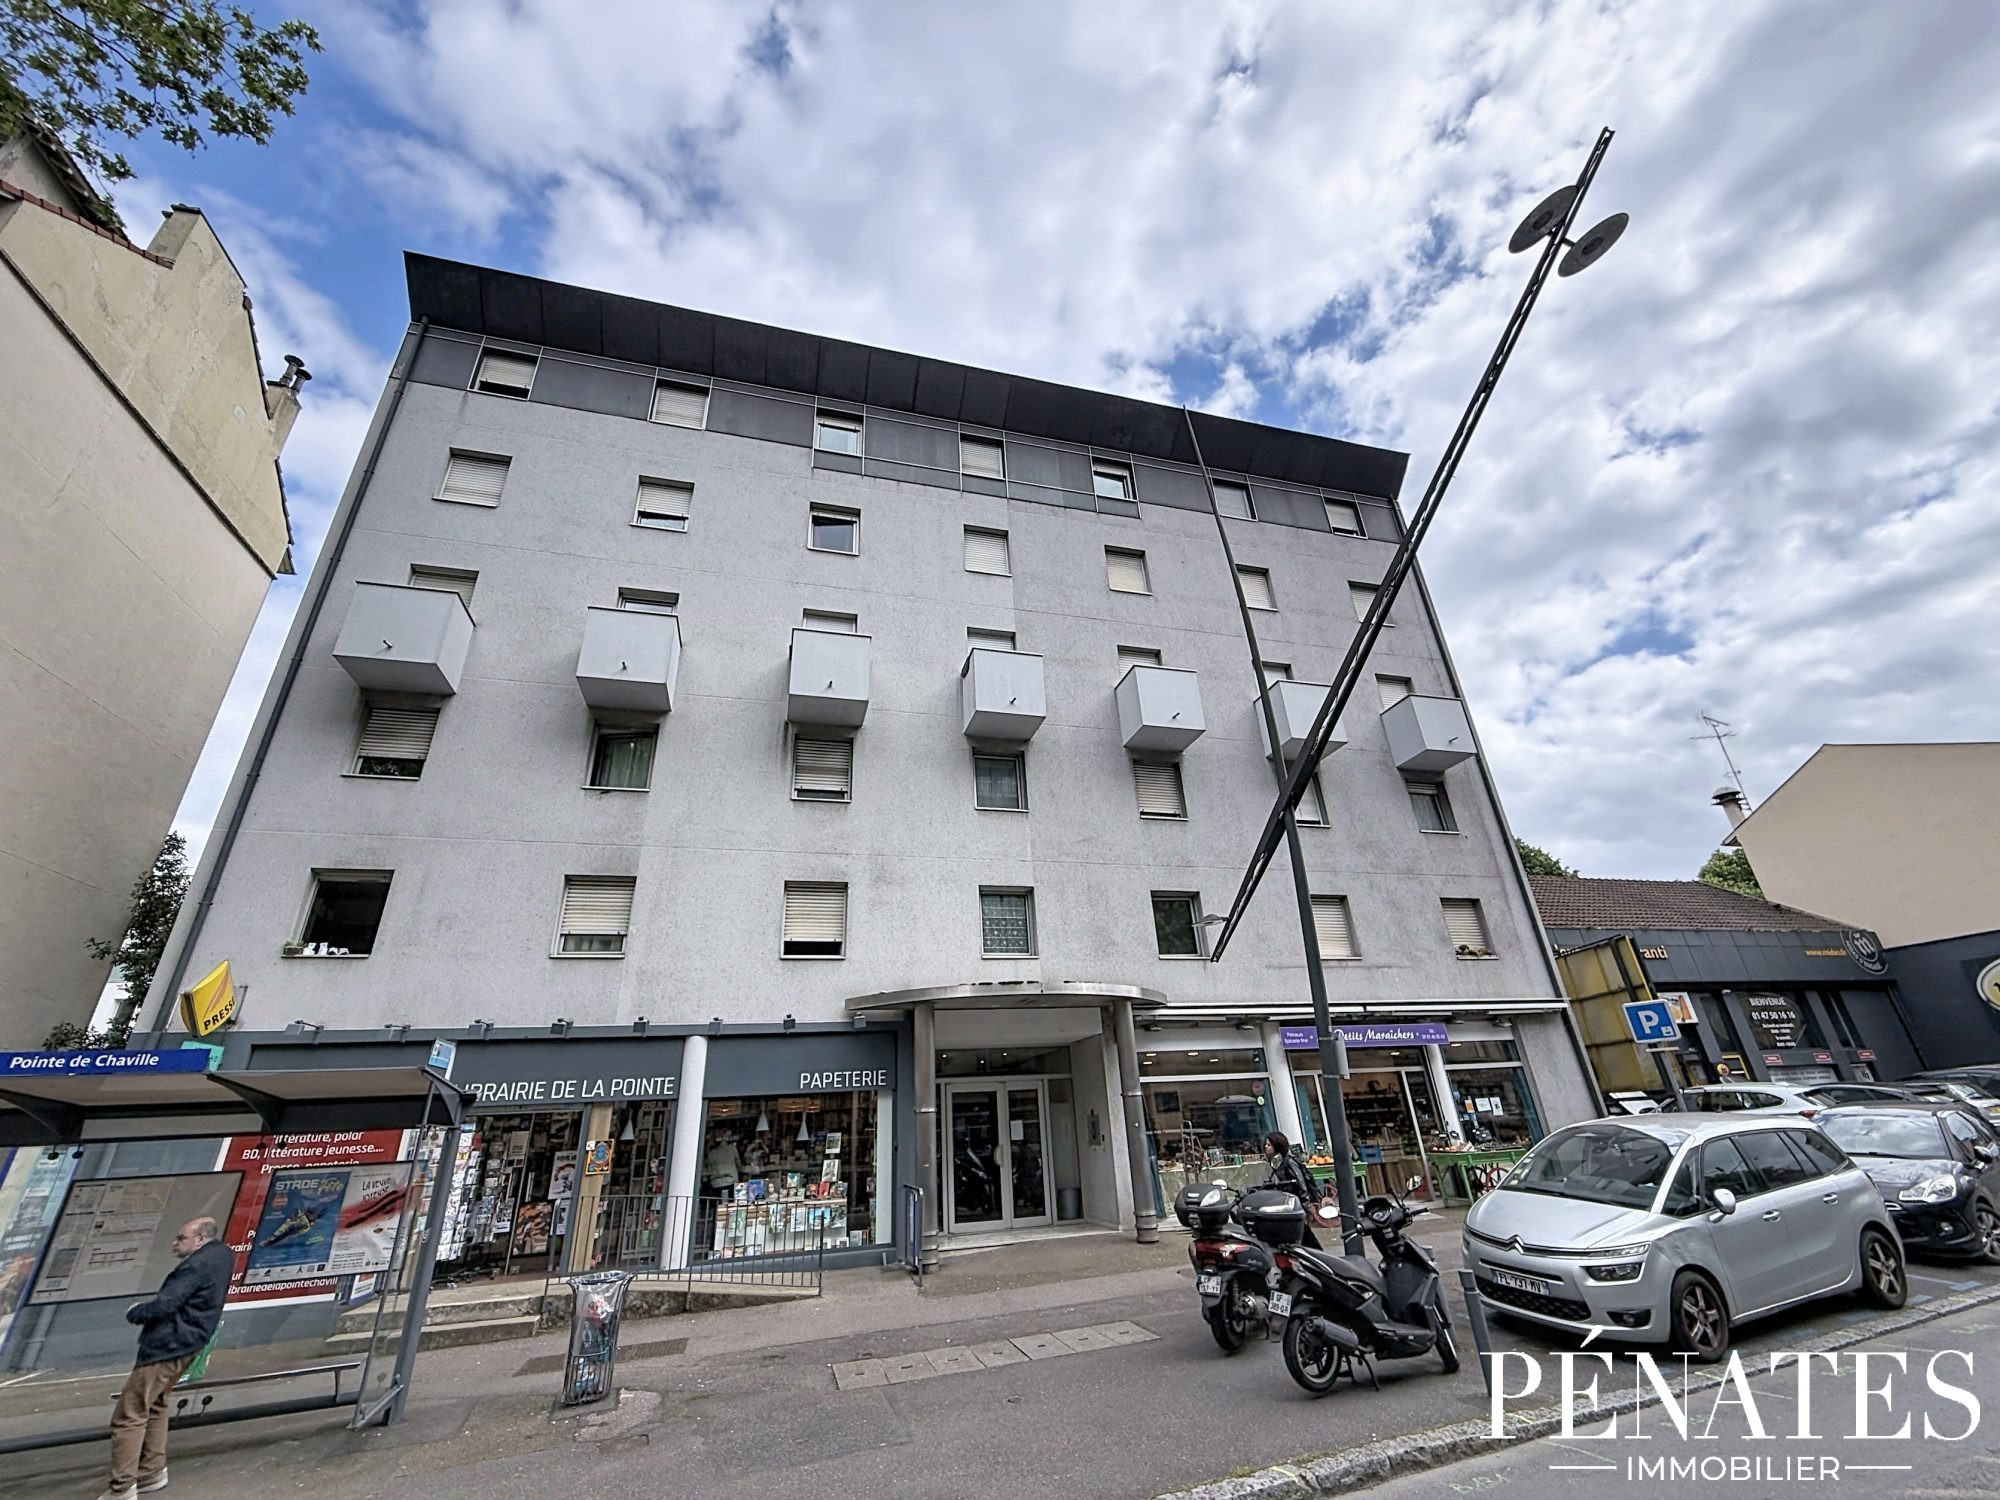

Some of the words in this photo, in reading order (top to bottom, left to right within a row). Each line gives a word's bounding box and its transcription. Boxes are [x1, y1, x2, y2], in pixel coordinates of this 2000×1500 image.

[1749, 997, 1787, 1006] BIENVENUE
[203, 995, 236, 1031] PRESSE
[1751, 1011, 1760, 1020] 01
[1637, 1010, 1660, 1034] P
[1364, 1028, 1415, 1043] Maraîchers
[9, 1056, 65, 1069] Pointe
[69, 1055, 91, 1068] de
[95, 1053, 160, 1067] Chaville
[800, 1069, 888, 1090] PAPETERIE
[464, 1081, 547, 1102] BRAIRIE
[550, 1079, 577, 1099] DE
[581, 1079, 605, 1098] LA
[610, 1076, 676, 1097] POINTE
[242, 1149, 261, 1161] BD,
